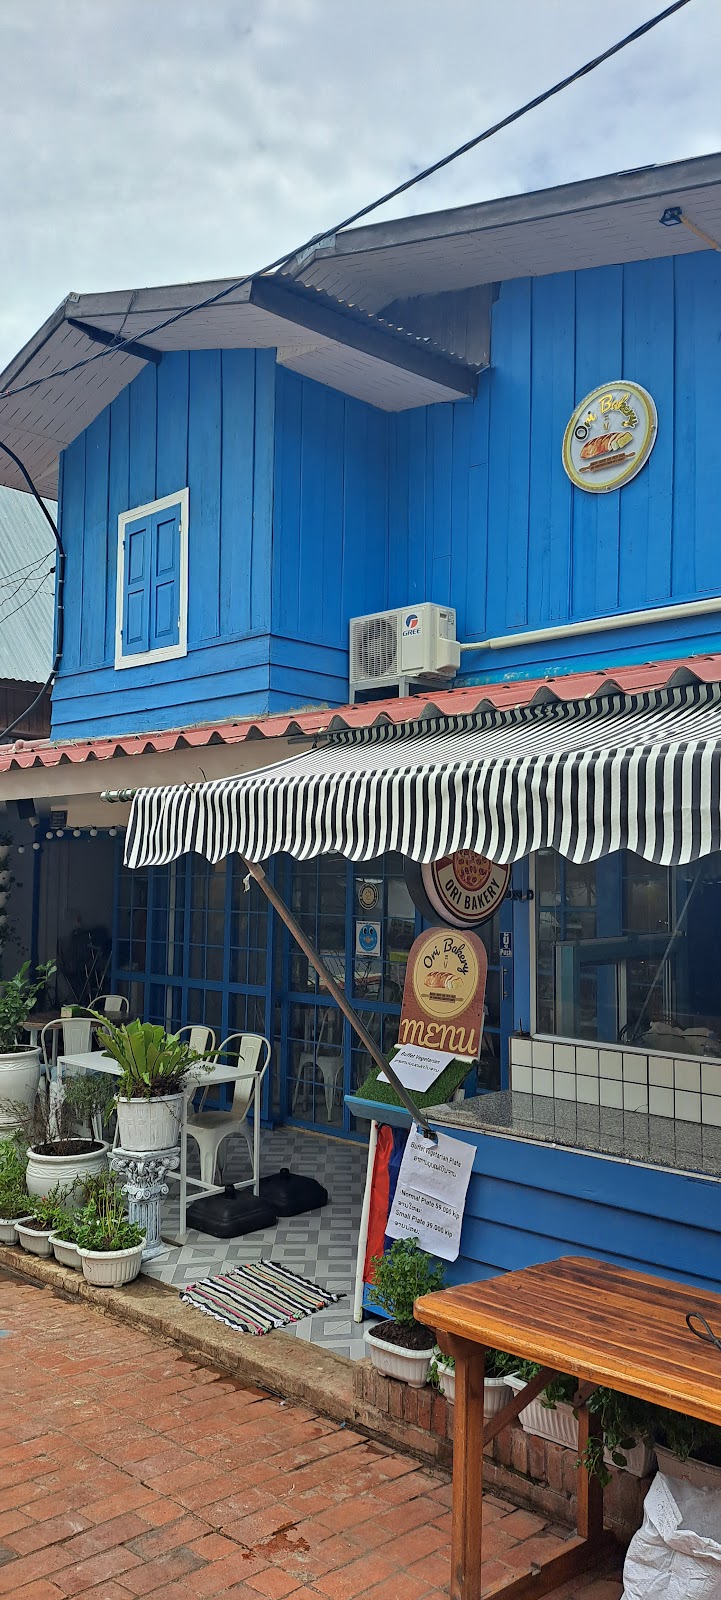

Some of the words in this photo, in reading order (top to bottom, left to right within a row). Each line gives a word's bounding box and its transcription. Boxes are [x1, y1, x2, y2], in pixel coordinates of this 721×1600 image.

[574, 411, 598, 440] Ori
[599, 393, 638, 429] Bakery
[402, 627, 422, 637] GREE
[445, 878, 461, 905] ORI
[464, 877, 501, 911] BAKERY
[423, 945, 441, 969] Ori
[443, 937, 469, 976] Bakery
[401, 1018, 478, 1055] MENU
[400, 1051, 416, 1059] Buffet
[415, 1054, 441, 1065] Vegetarian
[410, 1141, 425, 1153] Buffet
[449, 1156, 461, 1168] Plate
[400, 1189, 421, 1201] Normal
[420, 1197, 435, 1208] Plate
[395, 1209, 412, 1220] Small
[411, 1215, 426, 1226] Plate
